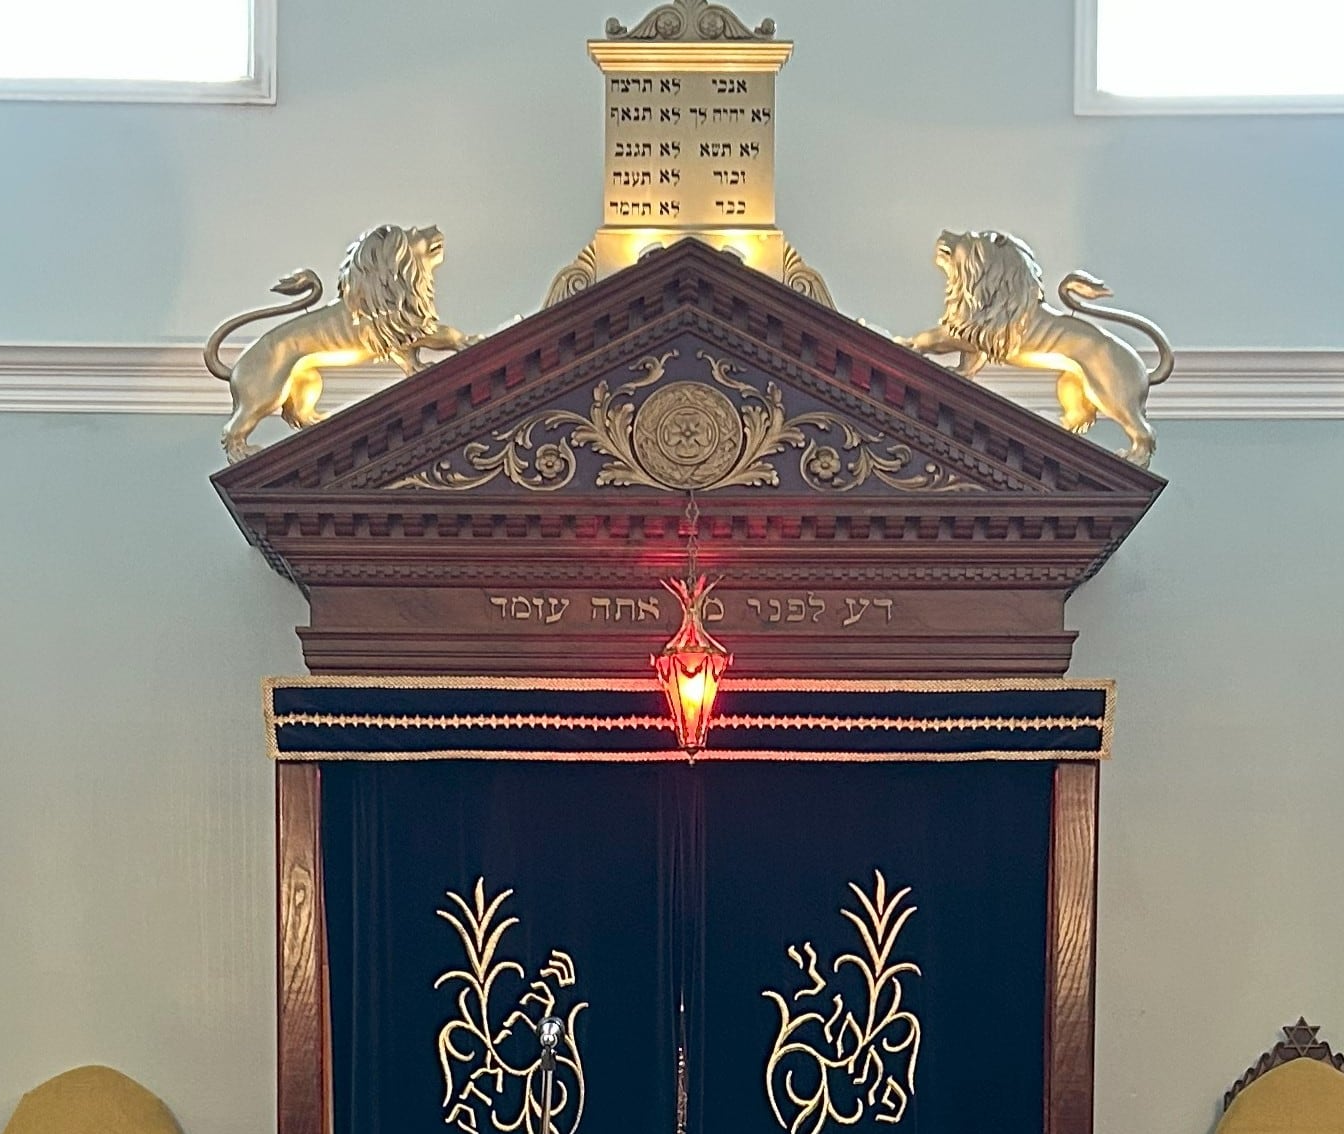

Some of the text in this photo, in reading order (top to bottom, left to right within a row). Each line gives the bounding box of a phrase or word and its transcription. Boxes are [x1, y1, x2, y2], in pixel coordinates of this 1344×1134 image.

[610, 78, 681, 96] לא תרצח
[711, 78, 748, 94] אנכי
[610, 106, 681, 127] לא תנאף
[689, 107, 772, 128] לא יהיה לך
[614, 141, 681, 160] לא תגנב
[699, 141, 760, 159] לא תשא
[612, 168, 681, 187] לא תענה
[712, 170, 746, 185] זכור
[609, 200, 680, 218] לא תחמד
[715, 200, 746, 215] כבד
[490, 596, 570, 624] עומד
[591, 596, 660, 621] אתה
[747, 591, 826, 622] לפני
[843, 597, 893, 626] דע
